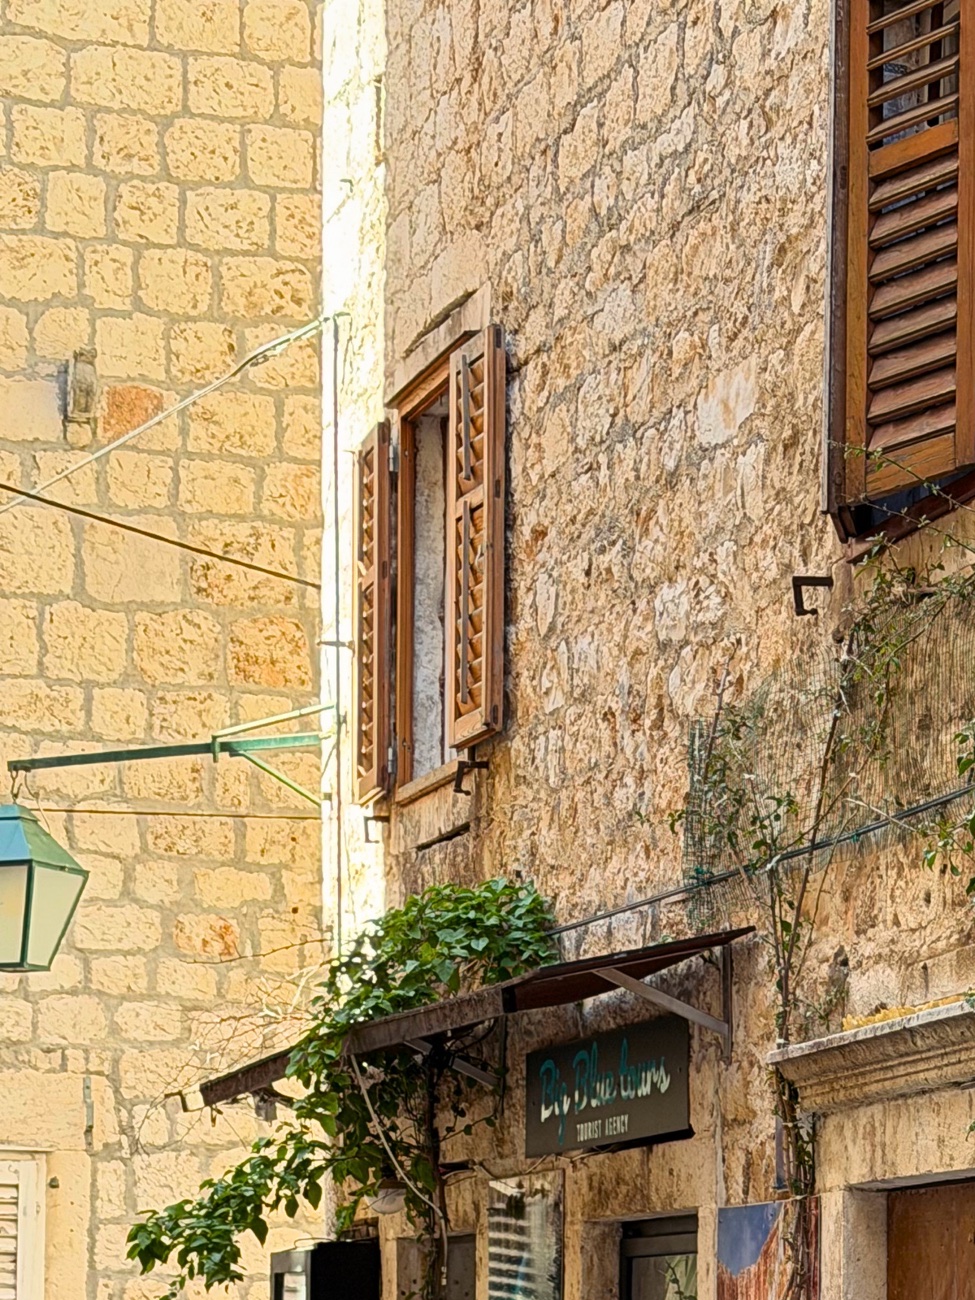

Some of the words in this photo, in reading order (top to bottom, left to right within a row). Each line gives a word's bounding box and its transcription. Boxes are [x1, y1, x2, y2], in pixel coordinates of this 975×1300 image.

[540, 1059, 571, 1145] Big
[573, 1040, 618, 1115] Blue
[576, 1119, 602, 1142] TOURIST
[605, 1114, 629, 1136] AGENCY
